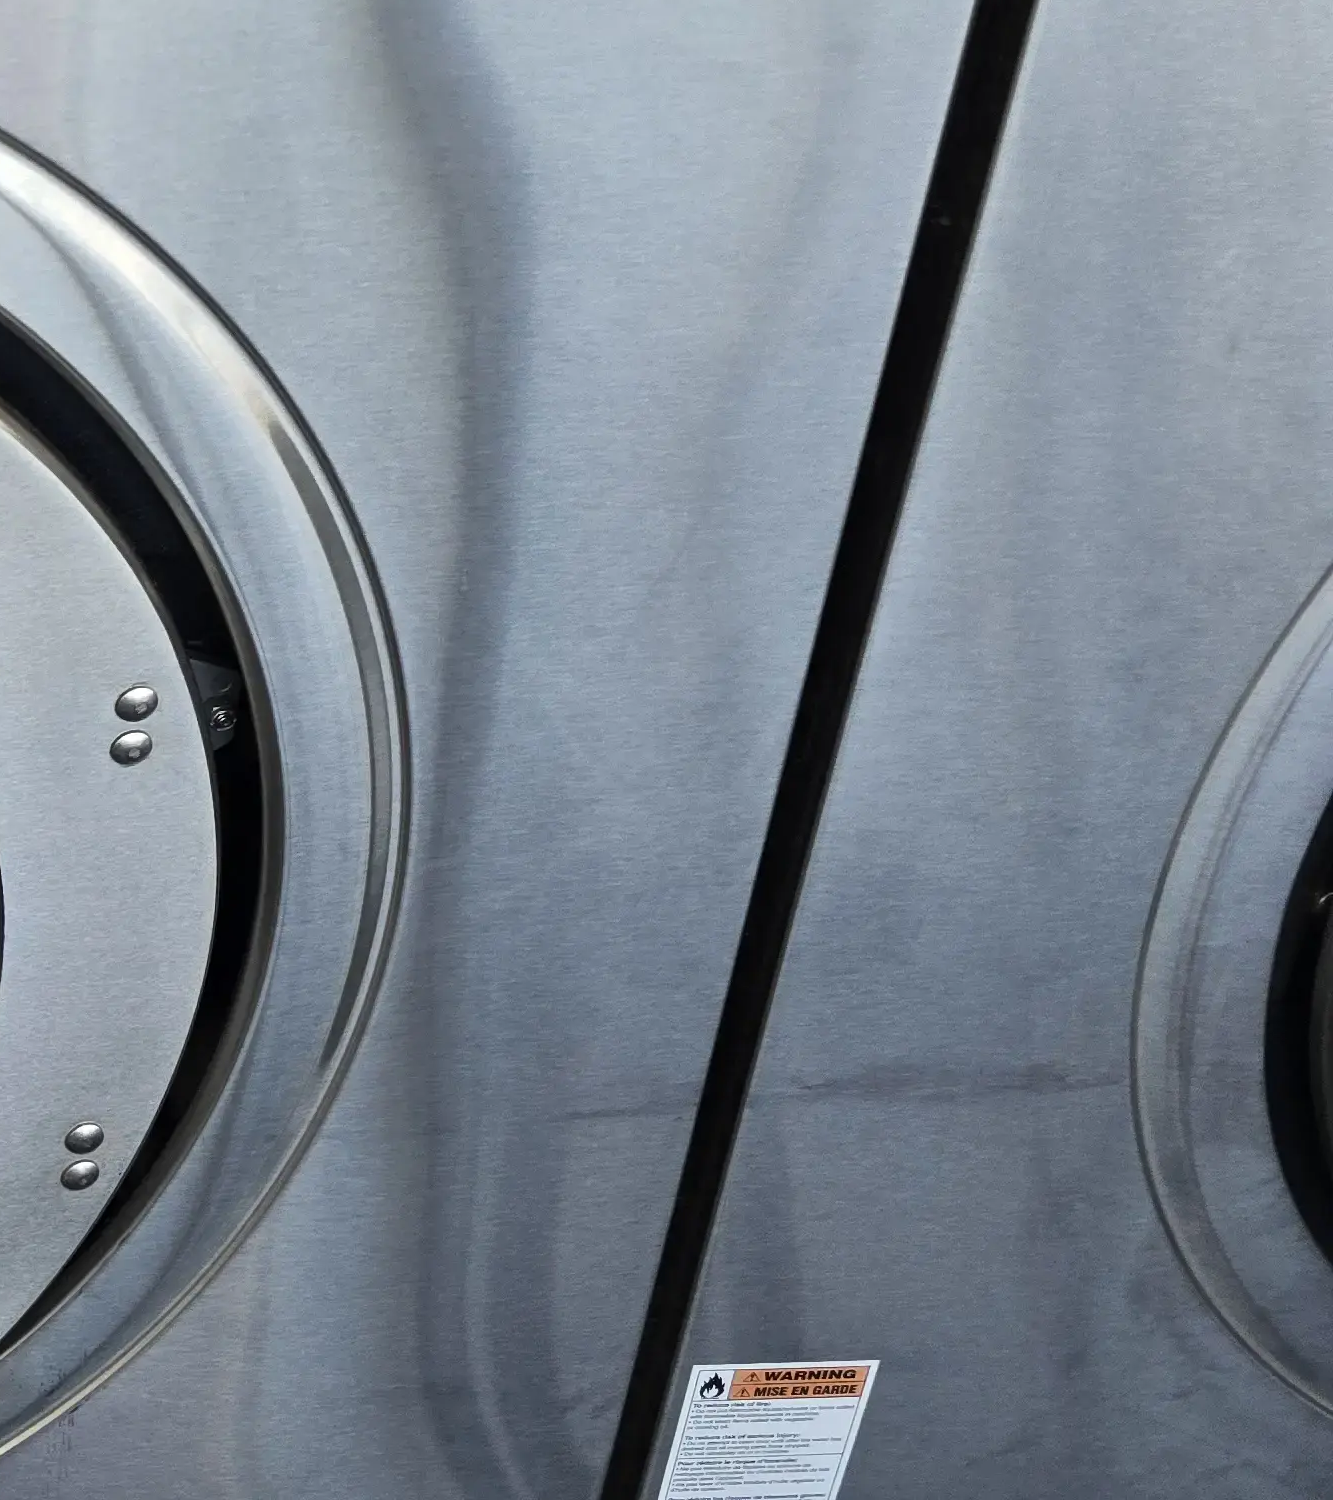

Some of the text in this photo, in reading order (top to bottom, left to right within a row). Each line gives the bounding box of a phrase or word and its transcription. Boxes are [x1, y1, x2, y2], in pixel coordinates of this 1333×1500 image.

[765, 1369, 856, 1382] WARNING
[753, 1384, 858, 1397] MISE EN GARDE
